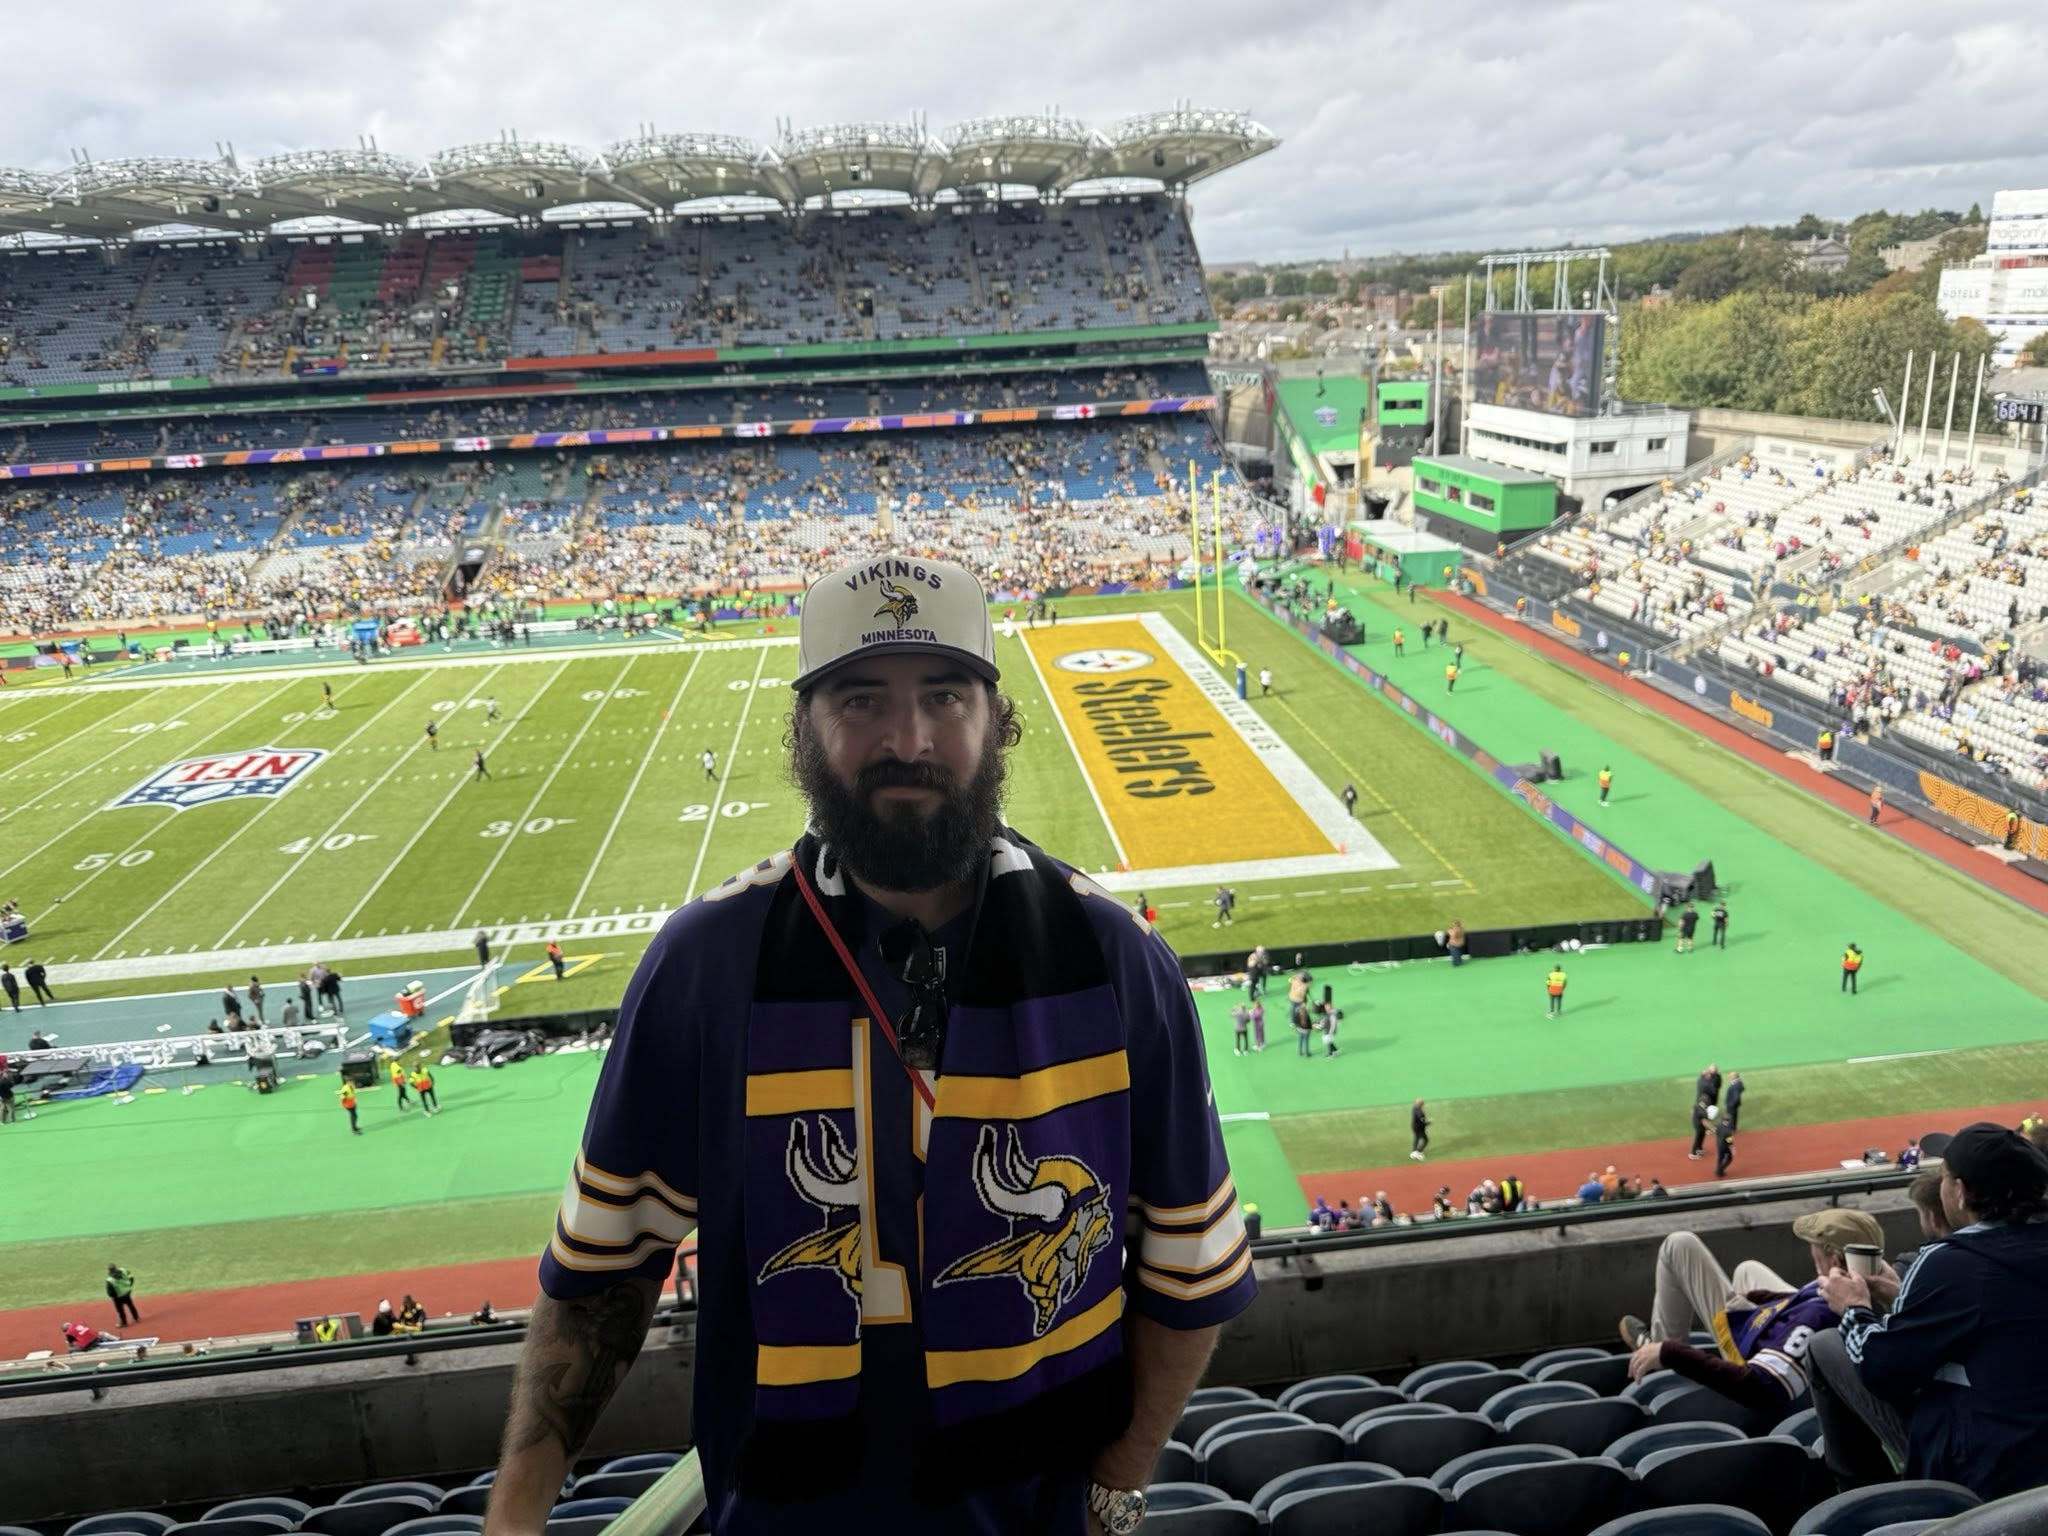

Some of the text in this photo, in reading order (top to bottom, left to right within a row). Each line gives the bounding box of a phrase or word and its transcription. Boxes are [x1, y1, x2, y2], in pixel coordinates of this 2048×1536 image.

[845, 560, 943, 591] VIKINGS
[861, 628, 938, 645] MINNESOTA
[1072, 678, 1215, 798] Steelers
[177, 754, 306, 783] NFL
[678, 801, 750, 822] 20
[480, 817, 555, 838] 30
[279, 833, 356, 854] 40
[73, 850, 155, 870] 50
